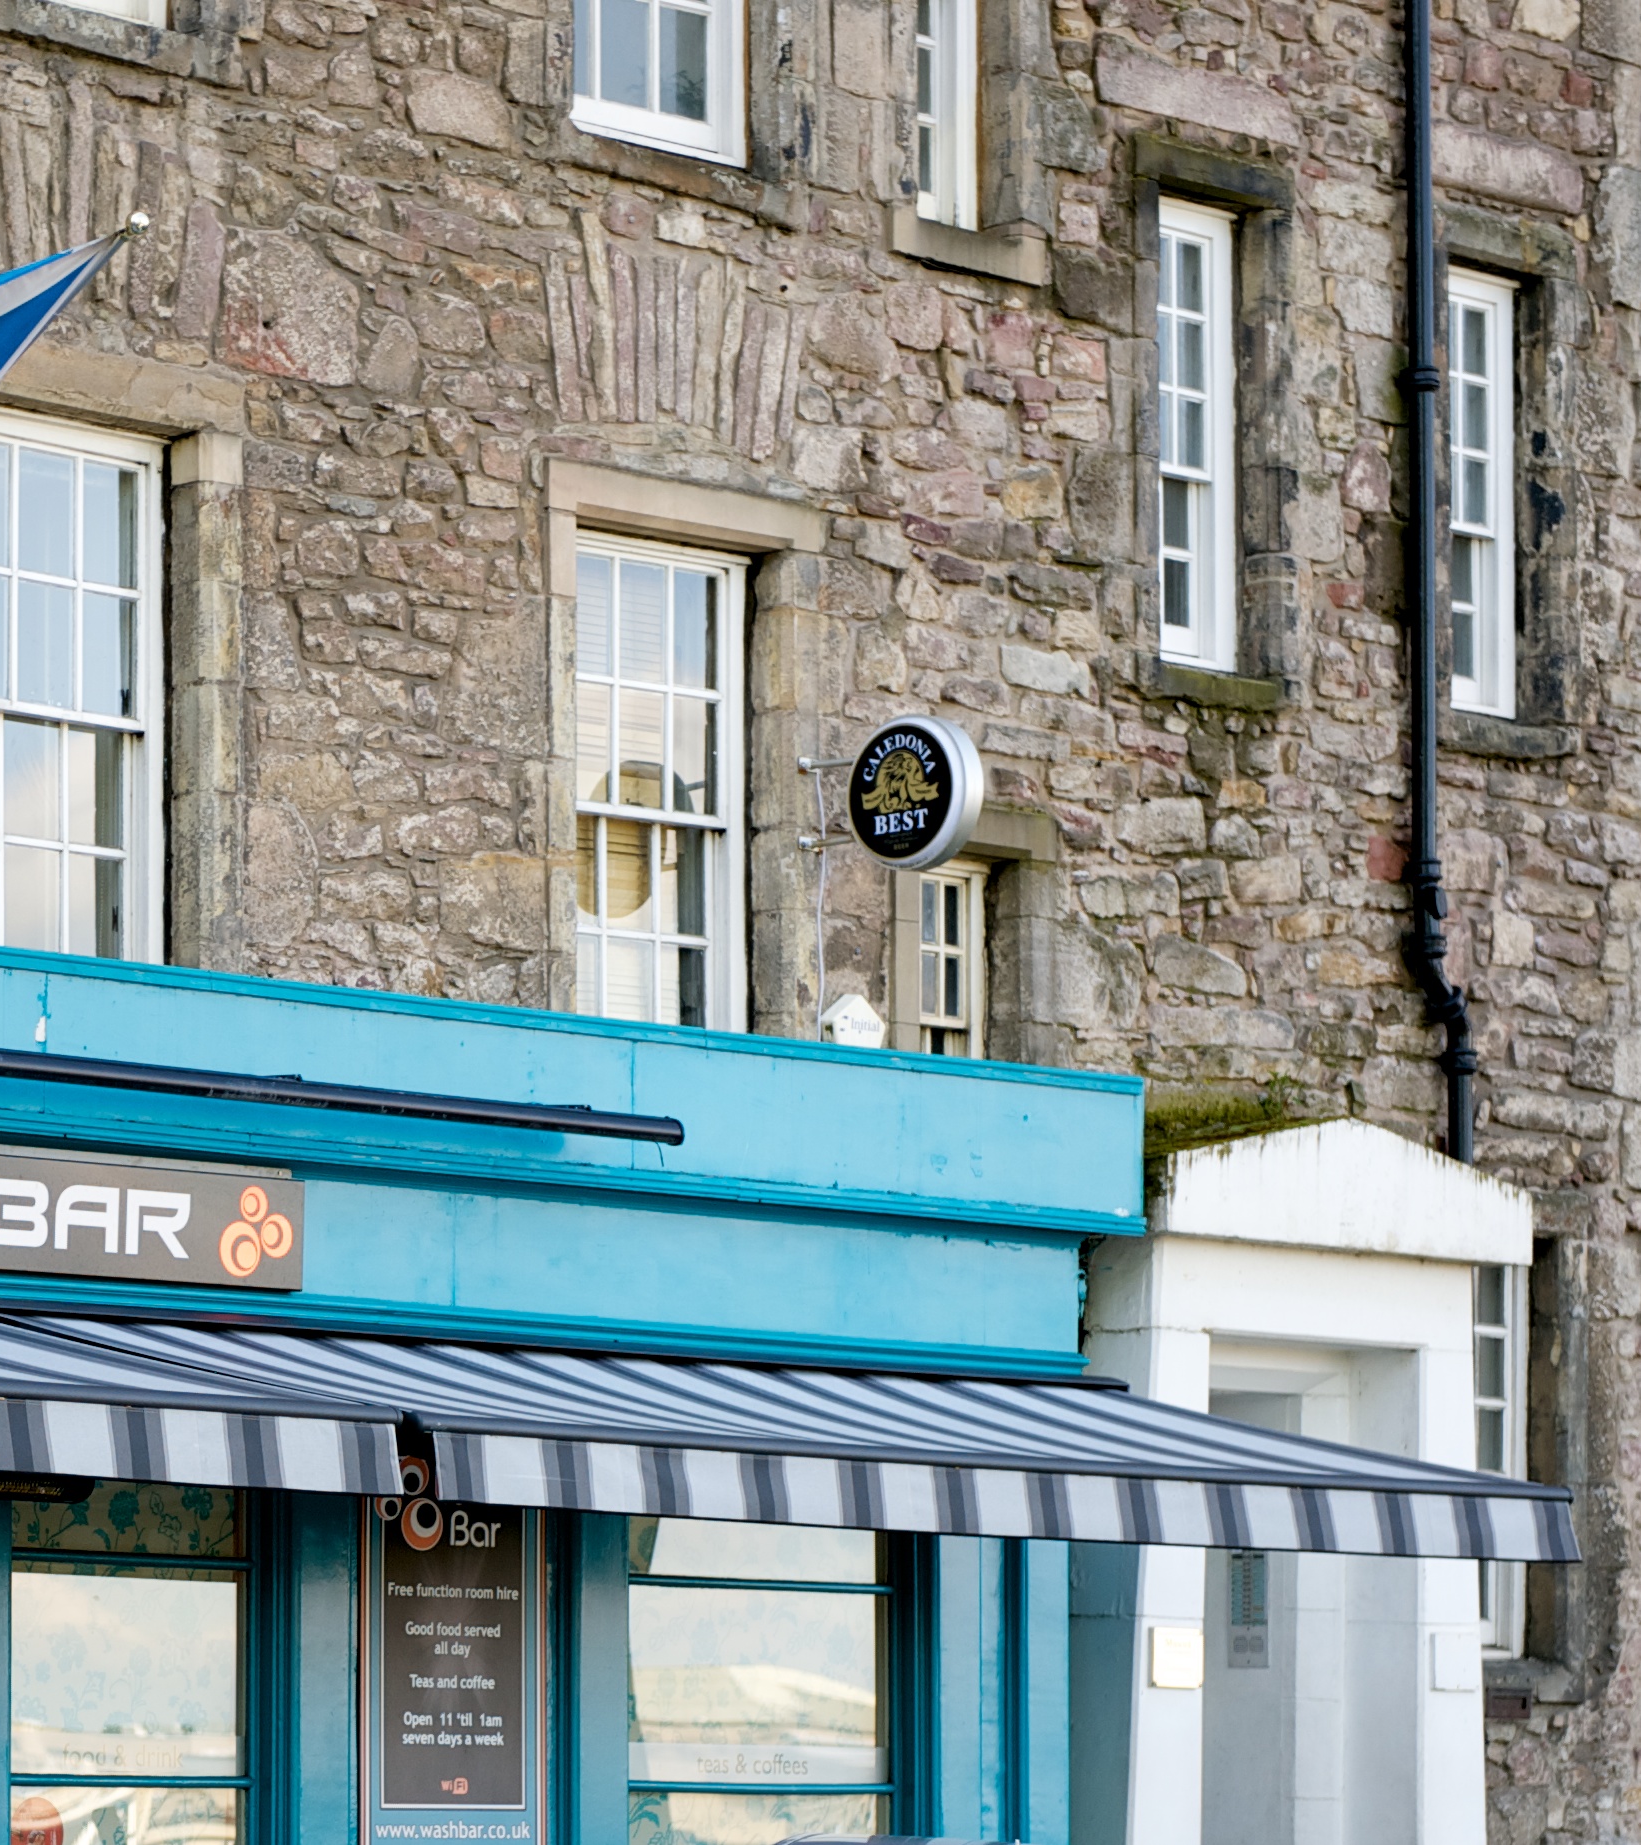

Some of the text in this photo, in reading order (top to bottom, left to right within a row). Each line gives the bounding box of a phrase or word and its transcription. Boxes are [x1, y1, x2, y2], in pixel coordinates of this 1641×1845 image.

[863, 733, 937, 782] CALEDONIA
[873, 807, 929, 836] BEST
[851, 1018, 880, 1032] Initial
[449, 1509, 501, 1548] Bar
[387, 1582, 519, 1600] Free function room hire
[405, 1621, 501, 1638] Good food served
[434, 1641, 471, 1658] all day
[409, 1673, 495, 1690] Teas and coffee
[403, 1711, 433, 1729] Open
[440, 1712, 452, 1726] 11
[480, 1713, 503, 1727] 1am
[402, 1731, 504, 1748] seven days a week
[62, 1743, 183, 1768] food & drink
[697, 1753, 808, 1775] teas & coffees
[375, 1820, 531, 1839] www.washbar.co.uk
